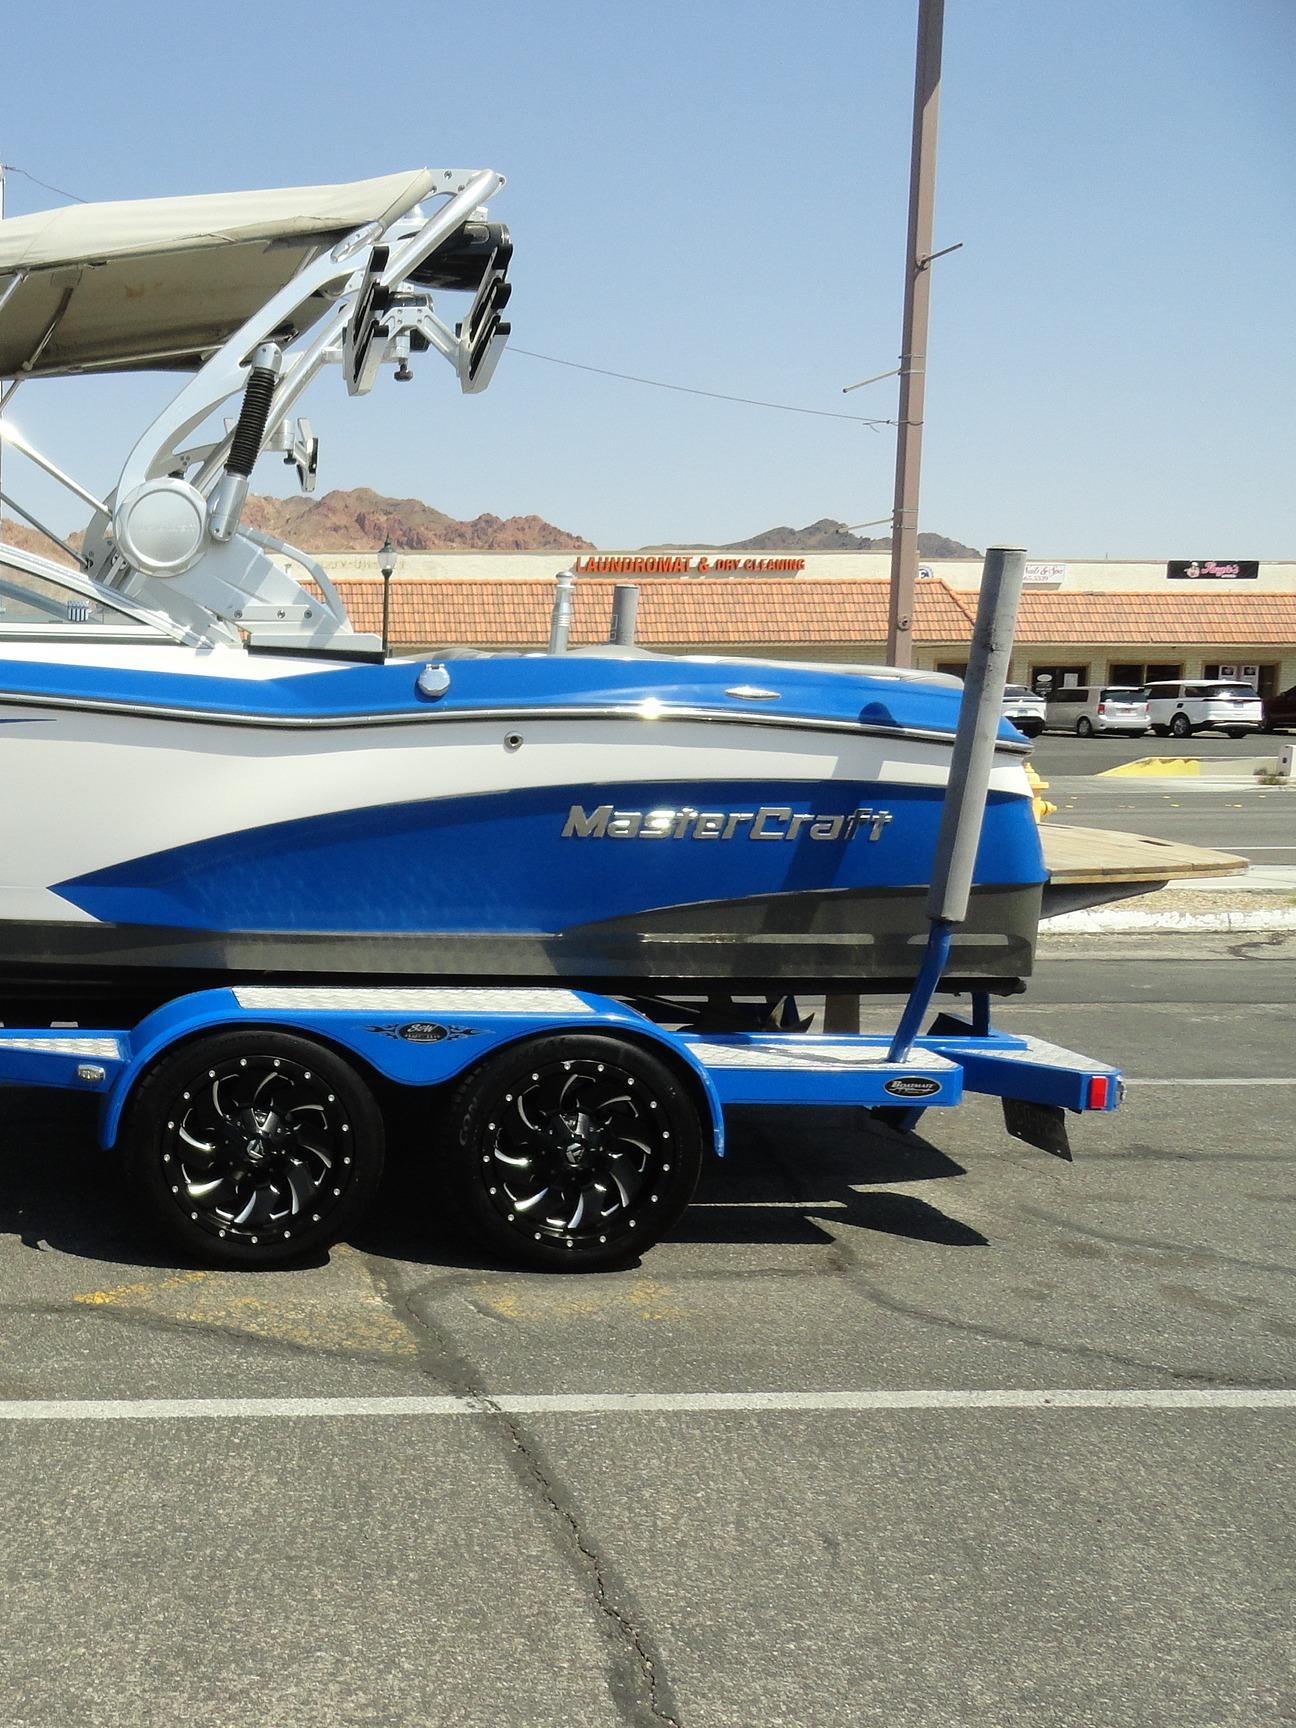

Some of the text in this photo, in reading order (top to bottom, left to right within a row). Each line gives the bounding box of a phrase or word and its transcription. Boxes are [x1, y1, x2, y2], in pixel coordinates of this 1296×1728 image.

[576, 556, 806, 573] LAUNDROMAT & DRY CLEANING
[561, 804, 893, 841] MasterCraft
